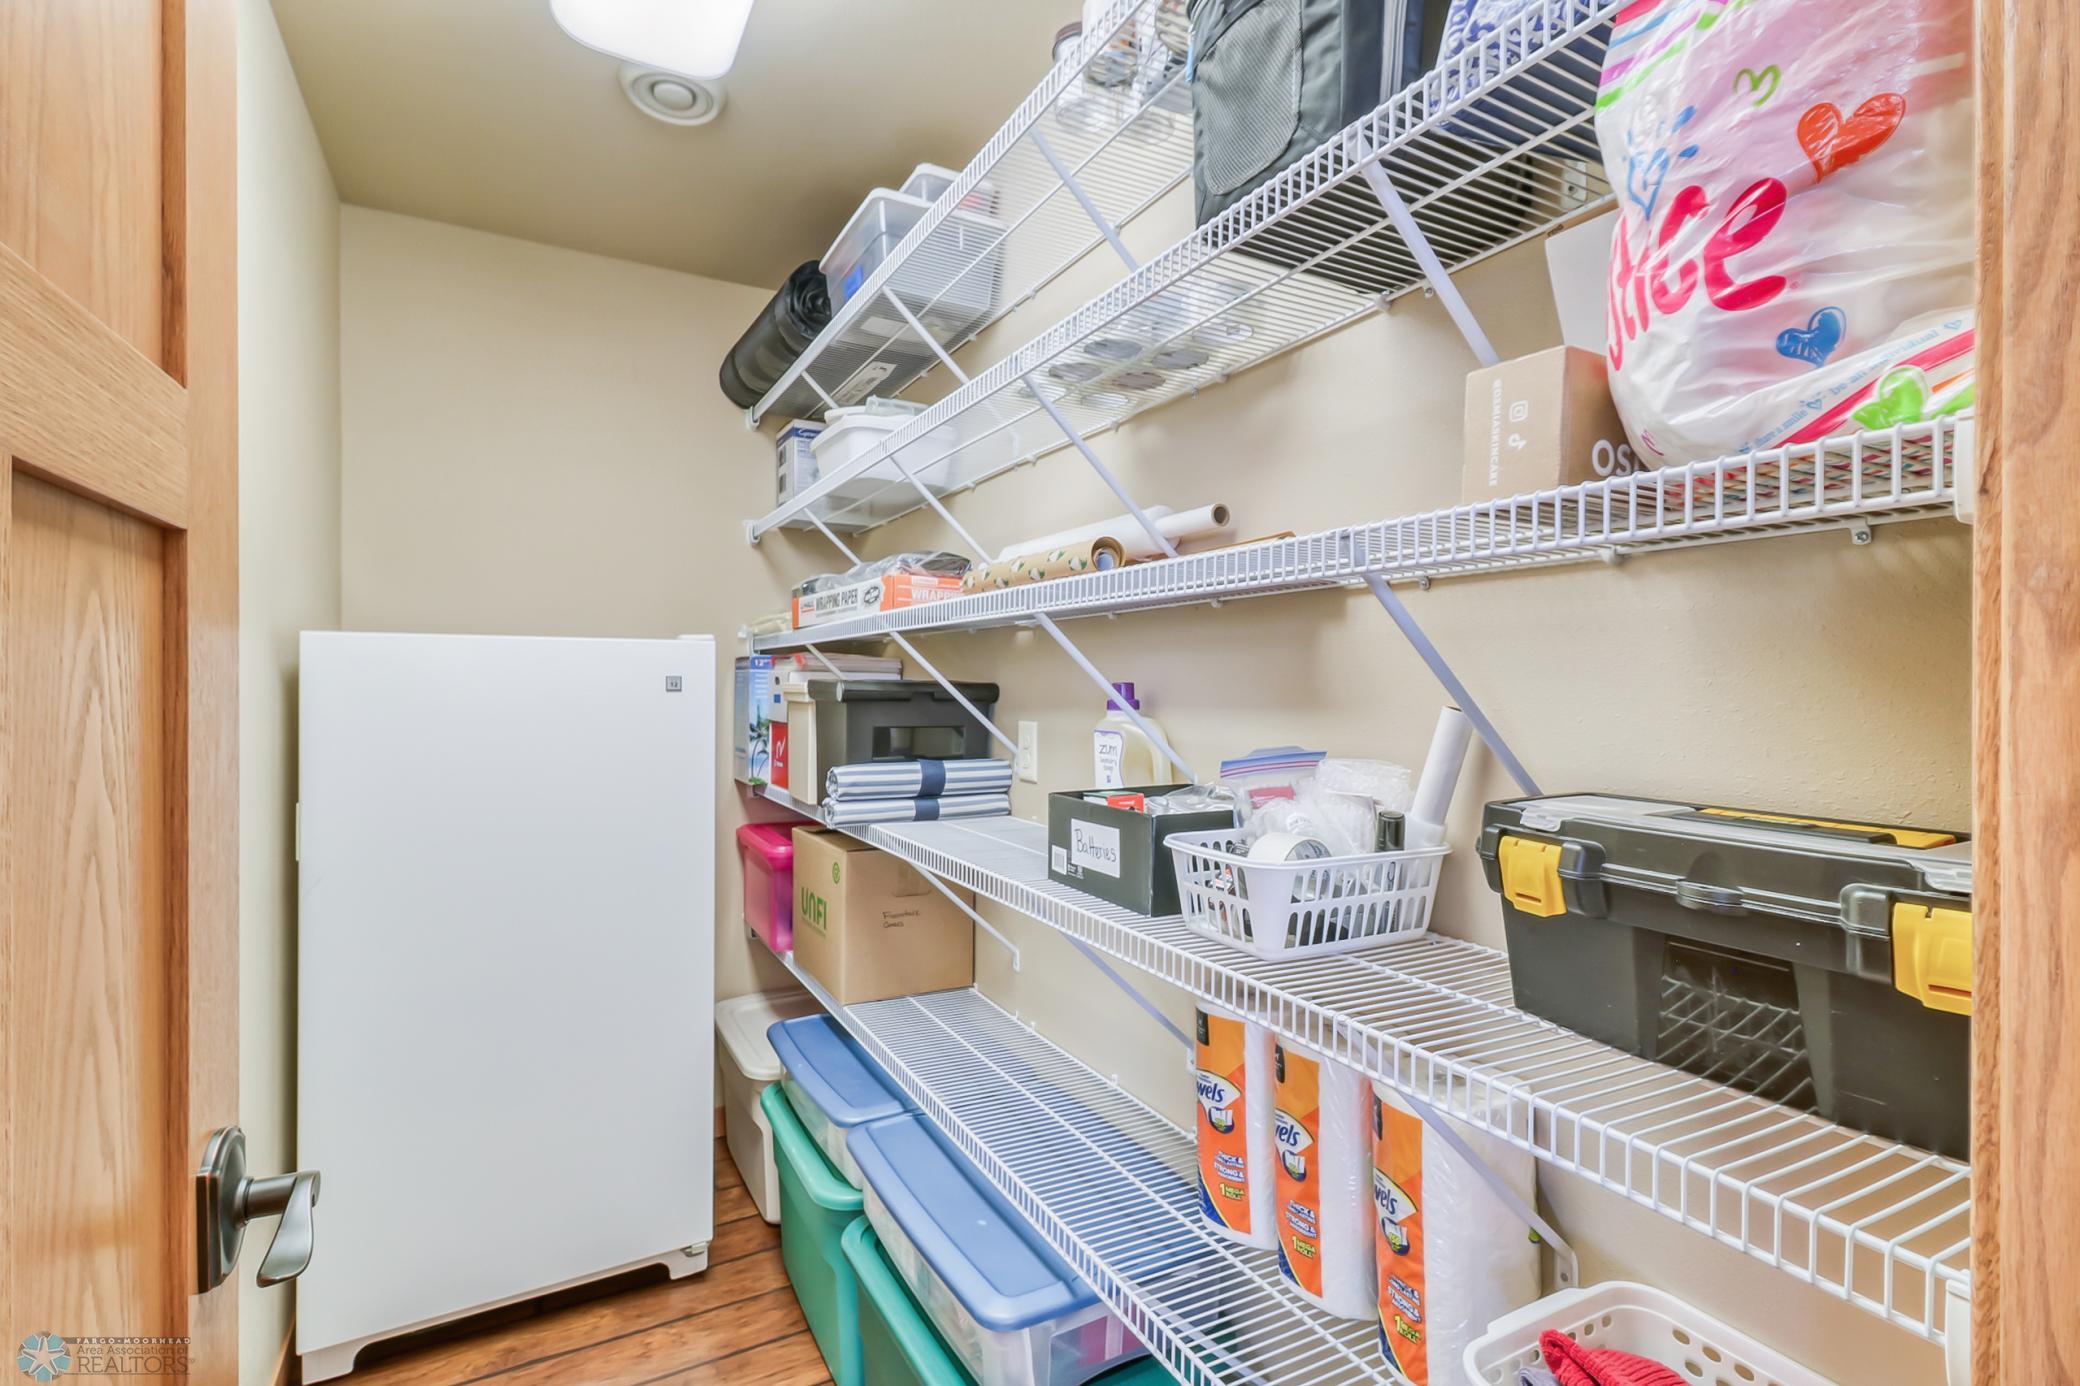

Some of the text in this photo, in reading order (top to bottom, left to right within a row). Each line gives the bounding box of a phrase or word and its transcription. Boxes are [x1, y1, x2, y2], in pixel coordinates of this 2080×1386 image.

[816, 592, 841, 611] WRAPPING
[841, 588, 858, 607] PAPER
[1074, 828, 1116, 863] Batteries
[801, 887, 827, 931] UNFI
[1220, 1183, 1226, 1197] 1
